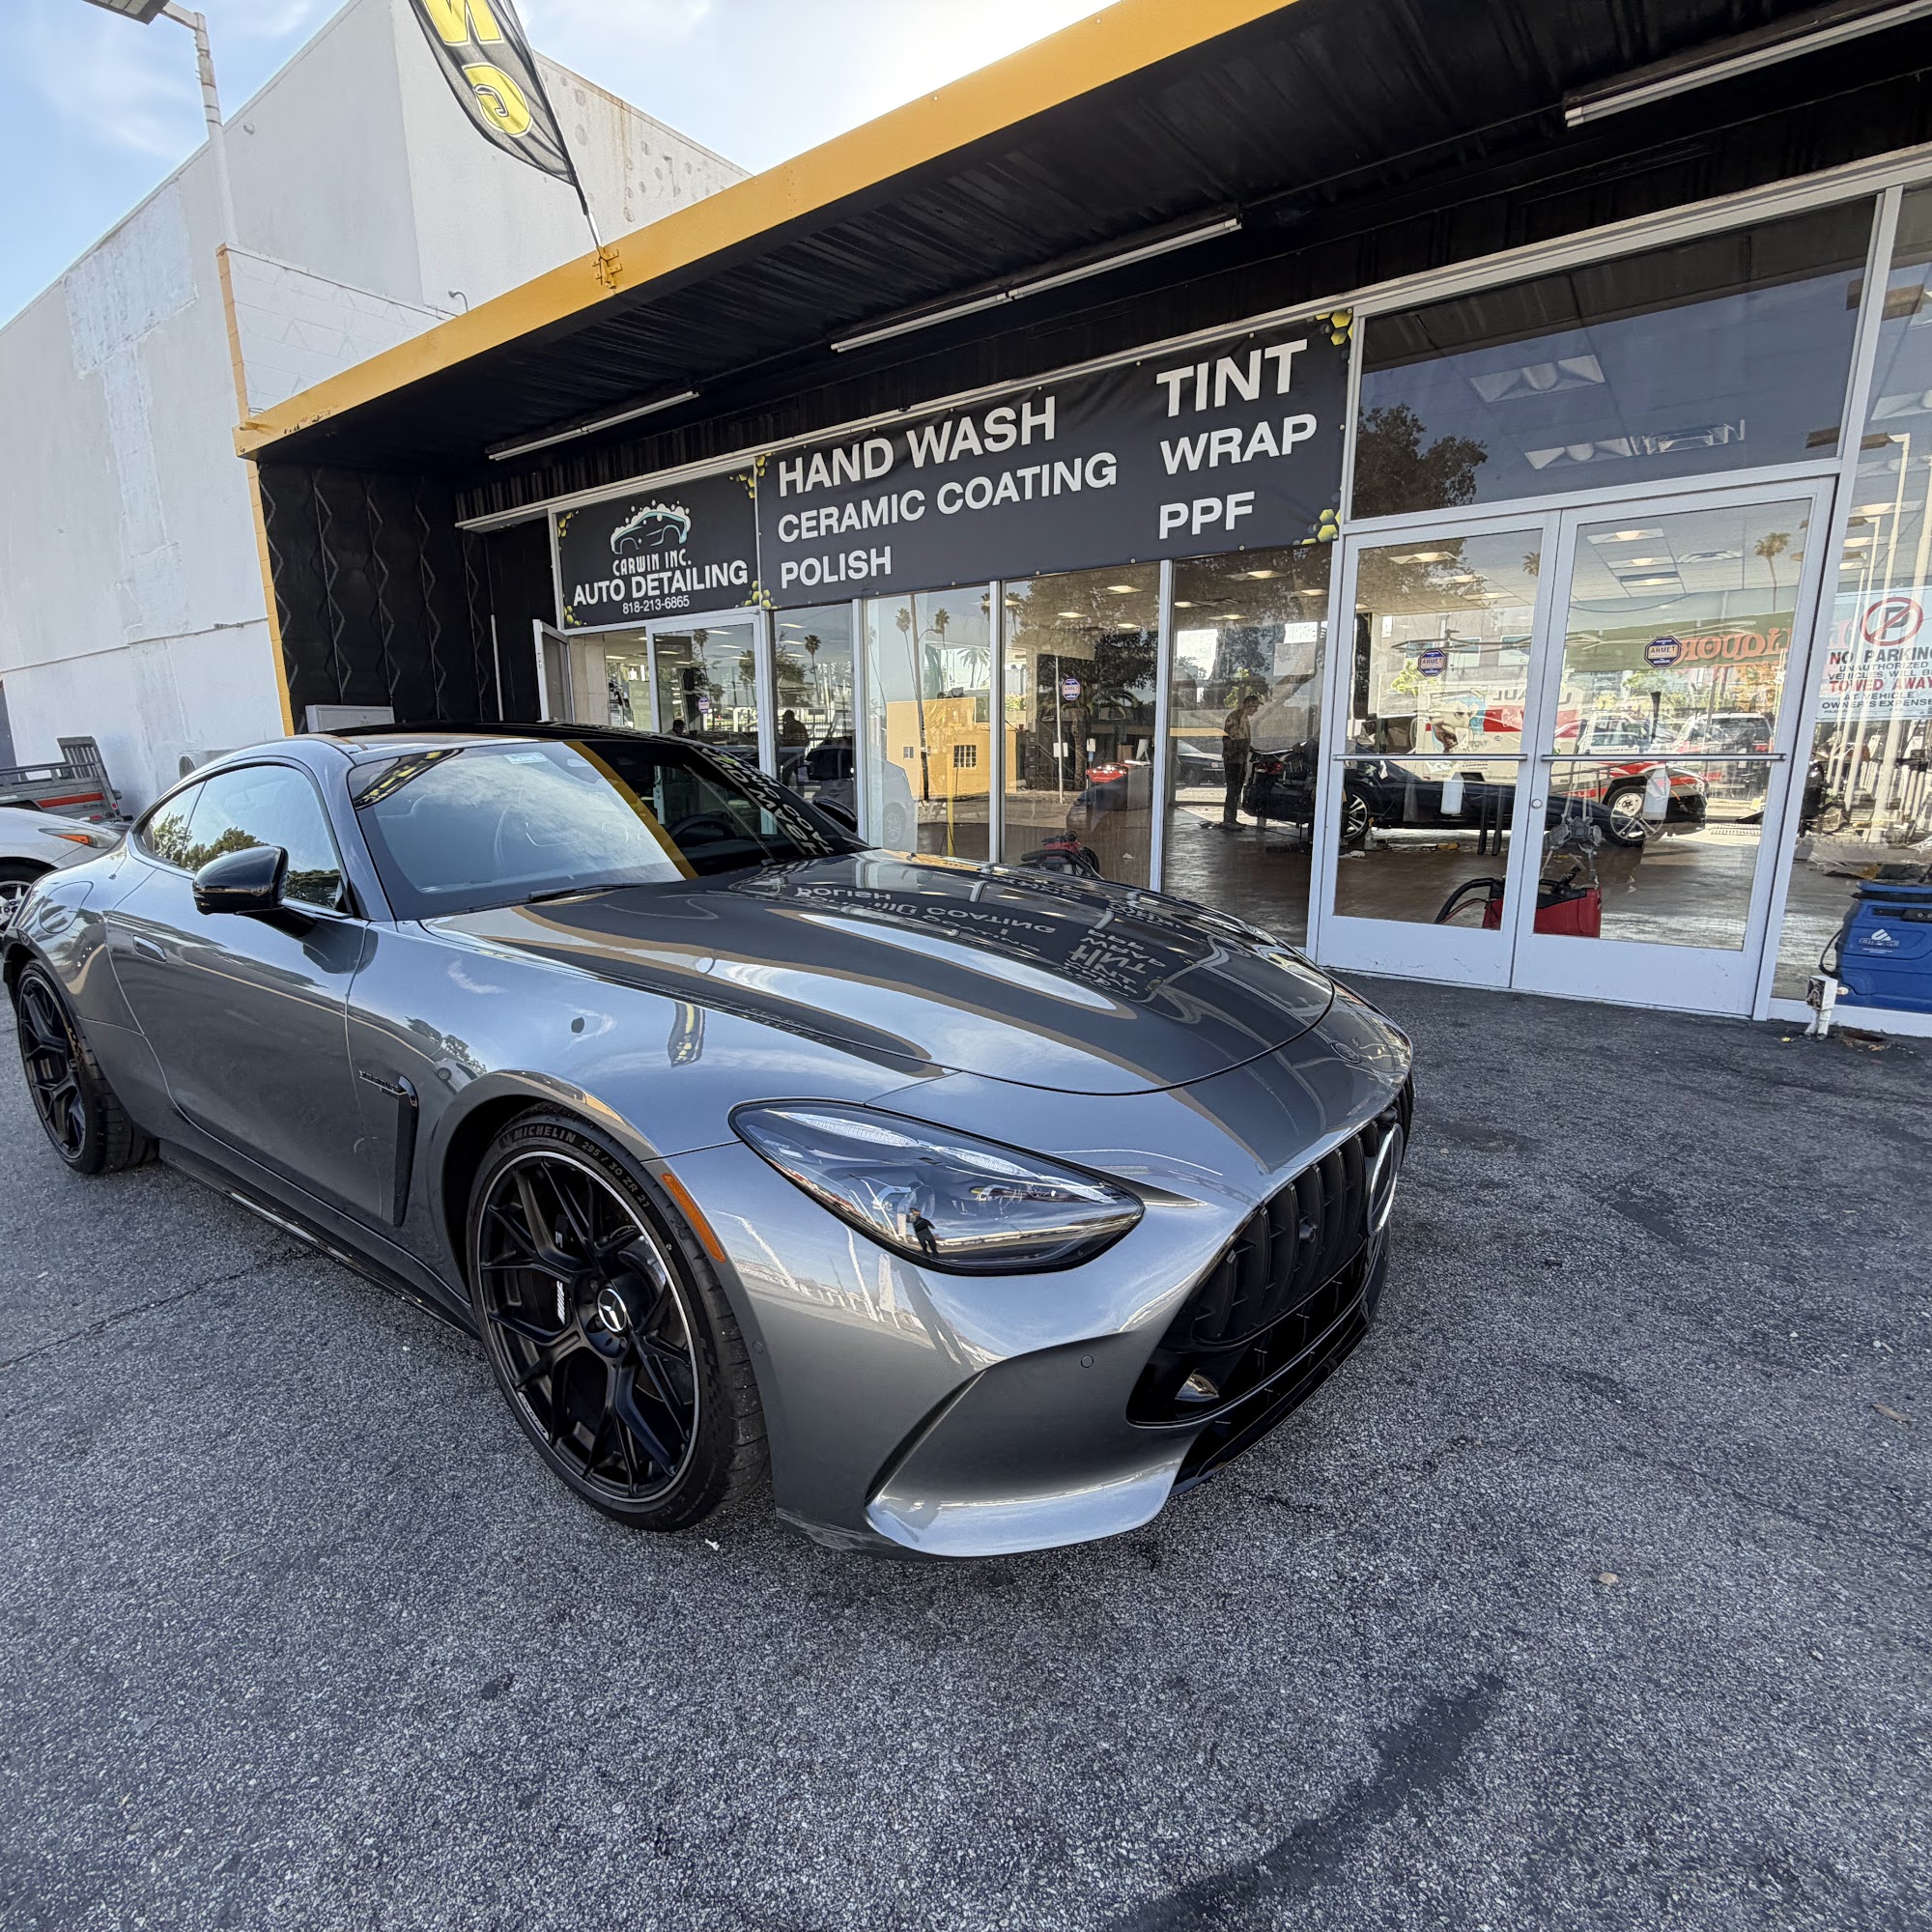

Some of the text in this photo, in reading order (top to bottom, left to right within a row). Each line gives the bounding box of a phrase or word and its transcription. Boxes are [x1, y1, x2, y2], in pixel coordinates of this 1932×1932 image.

[1156, 339, 1308, 417] TINT
[778, 395, 1056, 497] HAND WASH
[1160, 413, 1318, 475] WRAP
[778, 452, 1117, 543] CERAMIC COATING
[1159, 492, 1255, 540] PPF
[612, 548, 692, 577] CARWIN INC.
[781, 546, 893, 589] POLISH
[573, 560, 749, 607] AUTO DETAILING
[622, 594, 691, 614] 818-213-6865
[1830, 646, 1932, 666] NO PARKIN
[1839, 661, 1929, 672] UNAUTHORIZED
[1828, 670, 1884, 680] VEHICLES
[1889, 669, 1918, 678] WILL
[1829, 678, 1885, 694] TOWED
[1822, 699, 1877, 710] OWNER'S
[1843, 691, 1916, 701] AT VEHICLE
[513, 1125, 577, 1144] MICHELIN
[582, 1142, 601, 1156] 295
[609, 1162, 623, 1176] 30
[623, 1177, 639, 1192] ZR
[637, 1193, 651, 1208] 21
